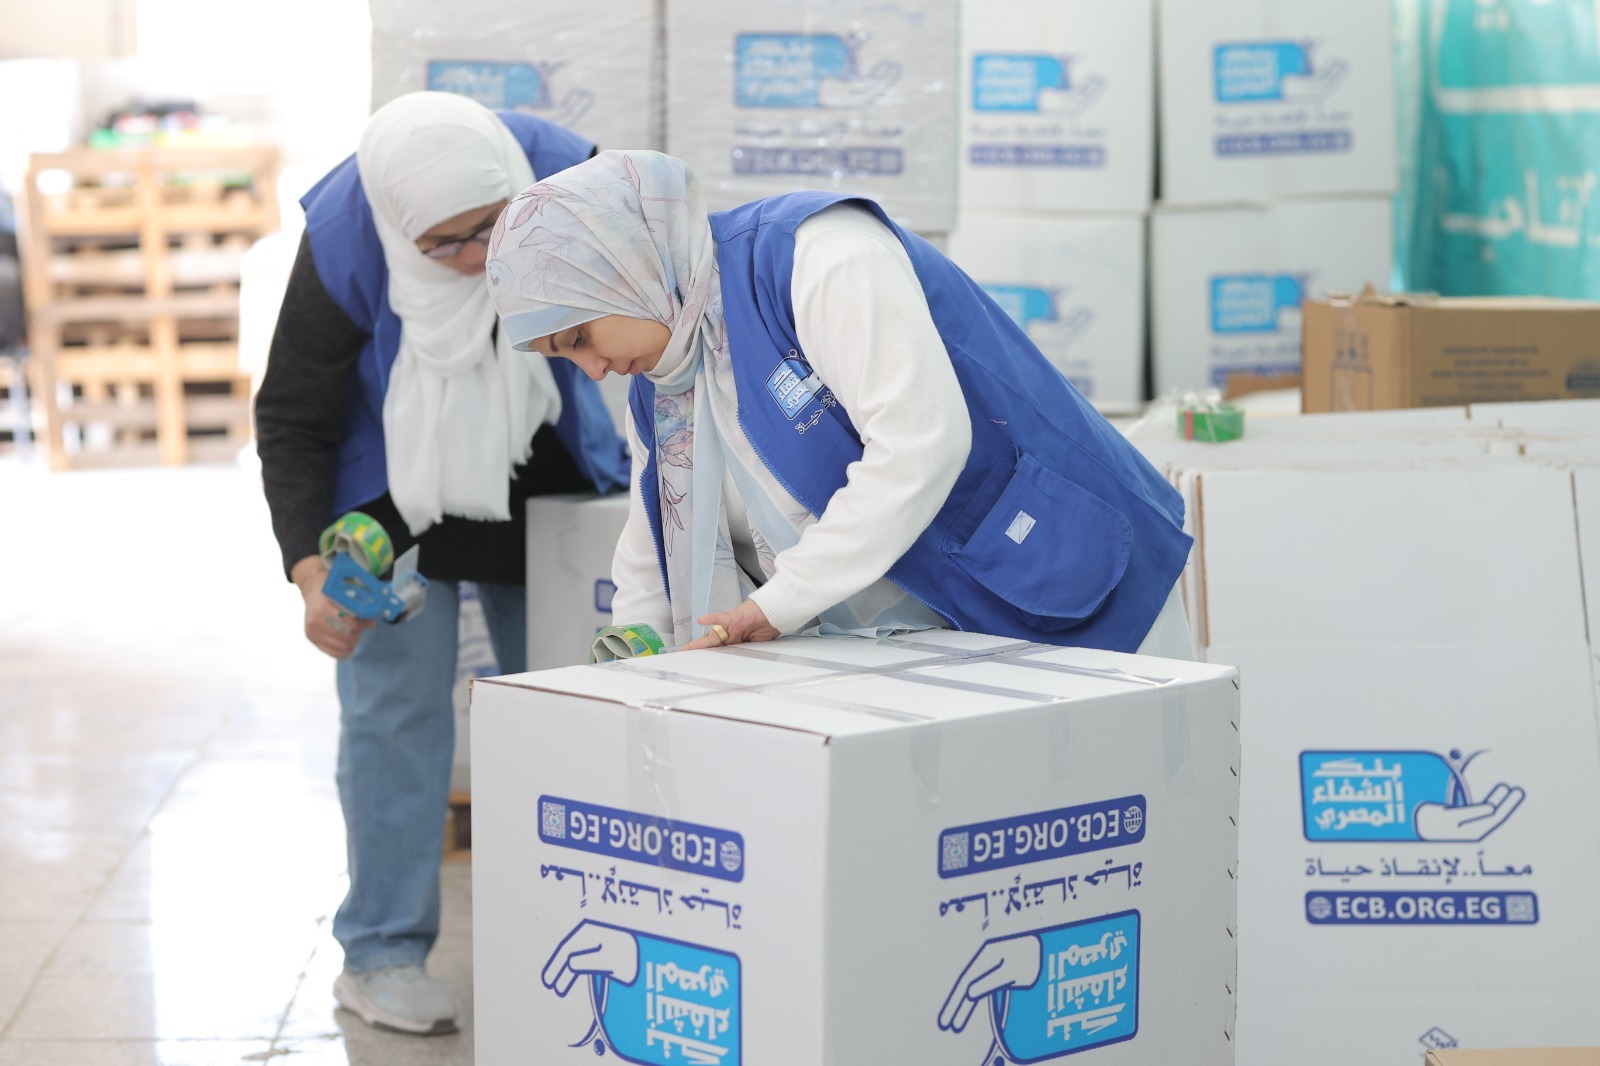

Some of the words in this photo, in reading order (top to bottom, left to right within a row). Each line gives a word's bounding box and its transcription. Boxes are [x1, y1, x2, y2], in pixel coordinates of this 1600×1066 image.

[795, 409, 823, 434] حياة
[1312, 757, 1402, 781] بنك
[1312, 778, 1406, 804] الشفاء
[973, 809, 1120, 862] ECB.ORG.EG
[1314, 803, 1405, 830] المصري
[570, 811, 716, 867] ECB.ORG.EG
[1083, 858, 1143, 890] حياة
[1305, 858, 1372, 883] حياة
[680, 888, 742, 930] حياة
[1336, 896, 1501, 919] ECB.ORG.EG
[1048, 930, 1128, 981] المصري
[646, 961, 730, 998] المصري
[1048, 963, 1128, 1012] الشفاء
[646, 992, 731, 1040] الشفاء
[1047, 1002, 1127, 1041] بنك
[646, 1023, 730, 1066] بنك
